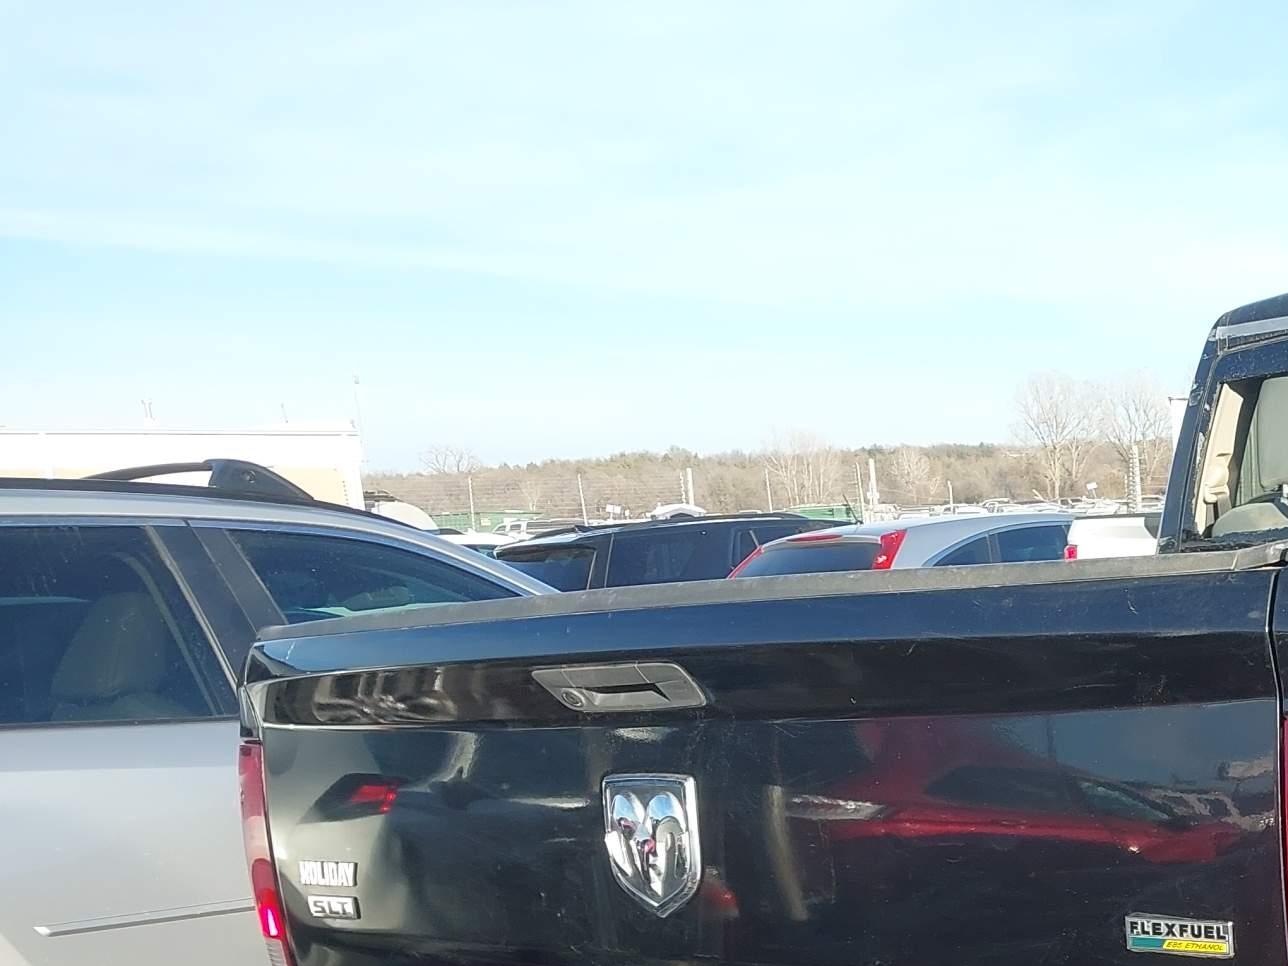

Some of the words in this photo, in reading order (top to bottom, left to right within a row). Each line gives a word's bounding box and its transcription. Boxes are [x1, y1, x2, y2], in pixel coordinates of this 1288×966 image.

[299, 860, 355, 887] HOLIDAY
[312, 899, 349, 916] SLT
[1129, 921, 1227, 941] FLEXFUEL
[1166, 941, 1183, 949] E85
[1184, 942, 1224, 952] ETHANOL
